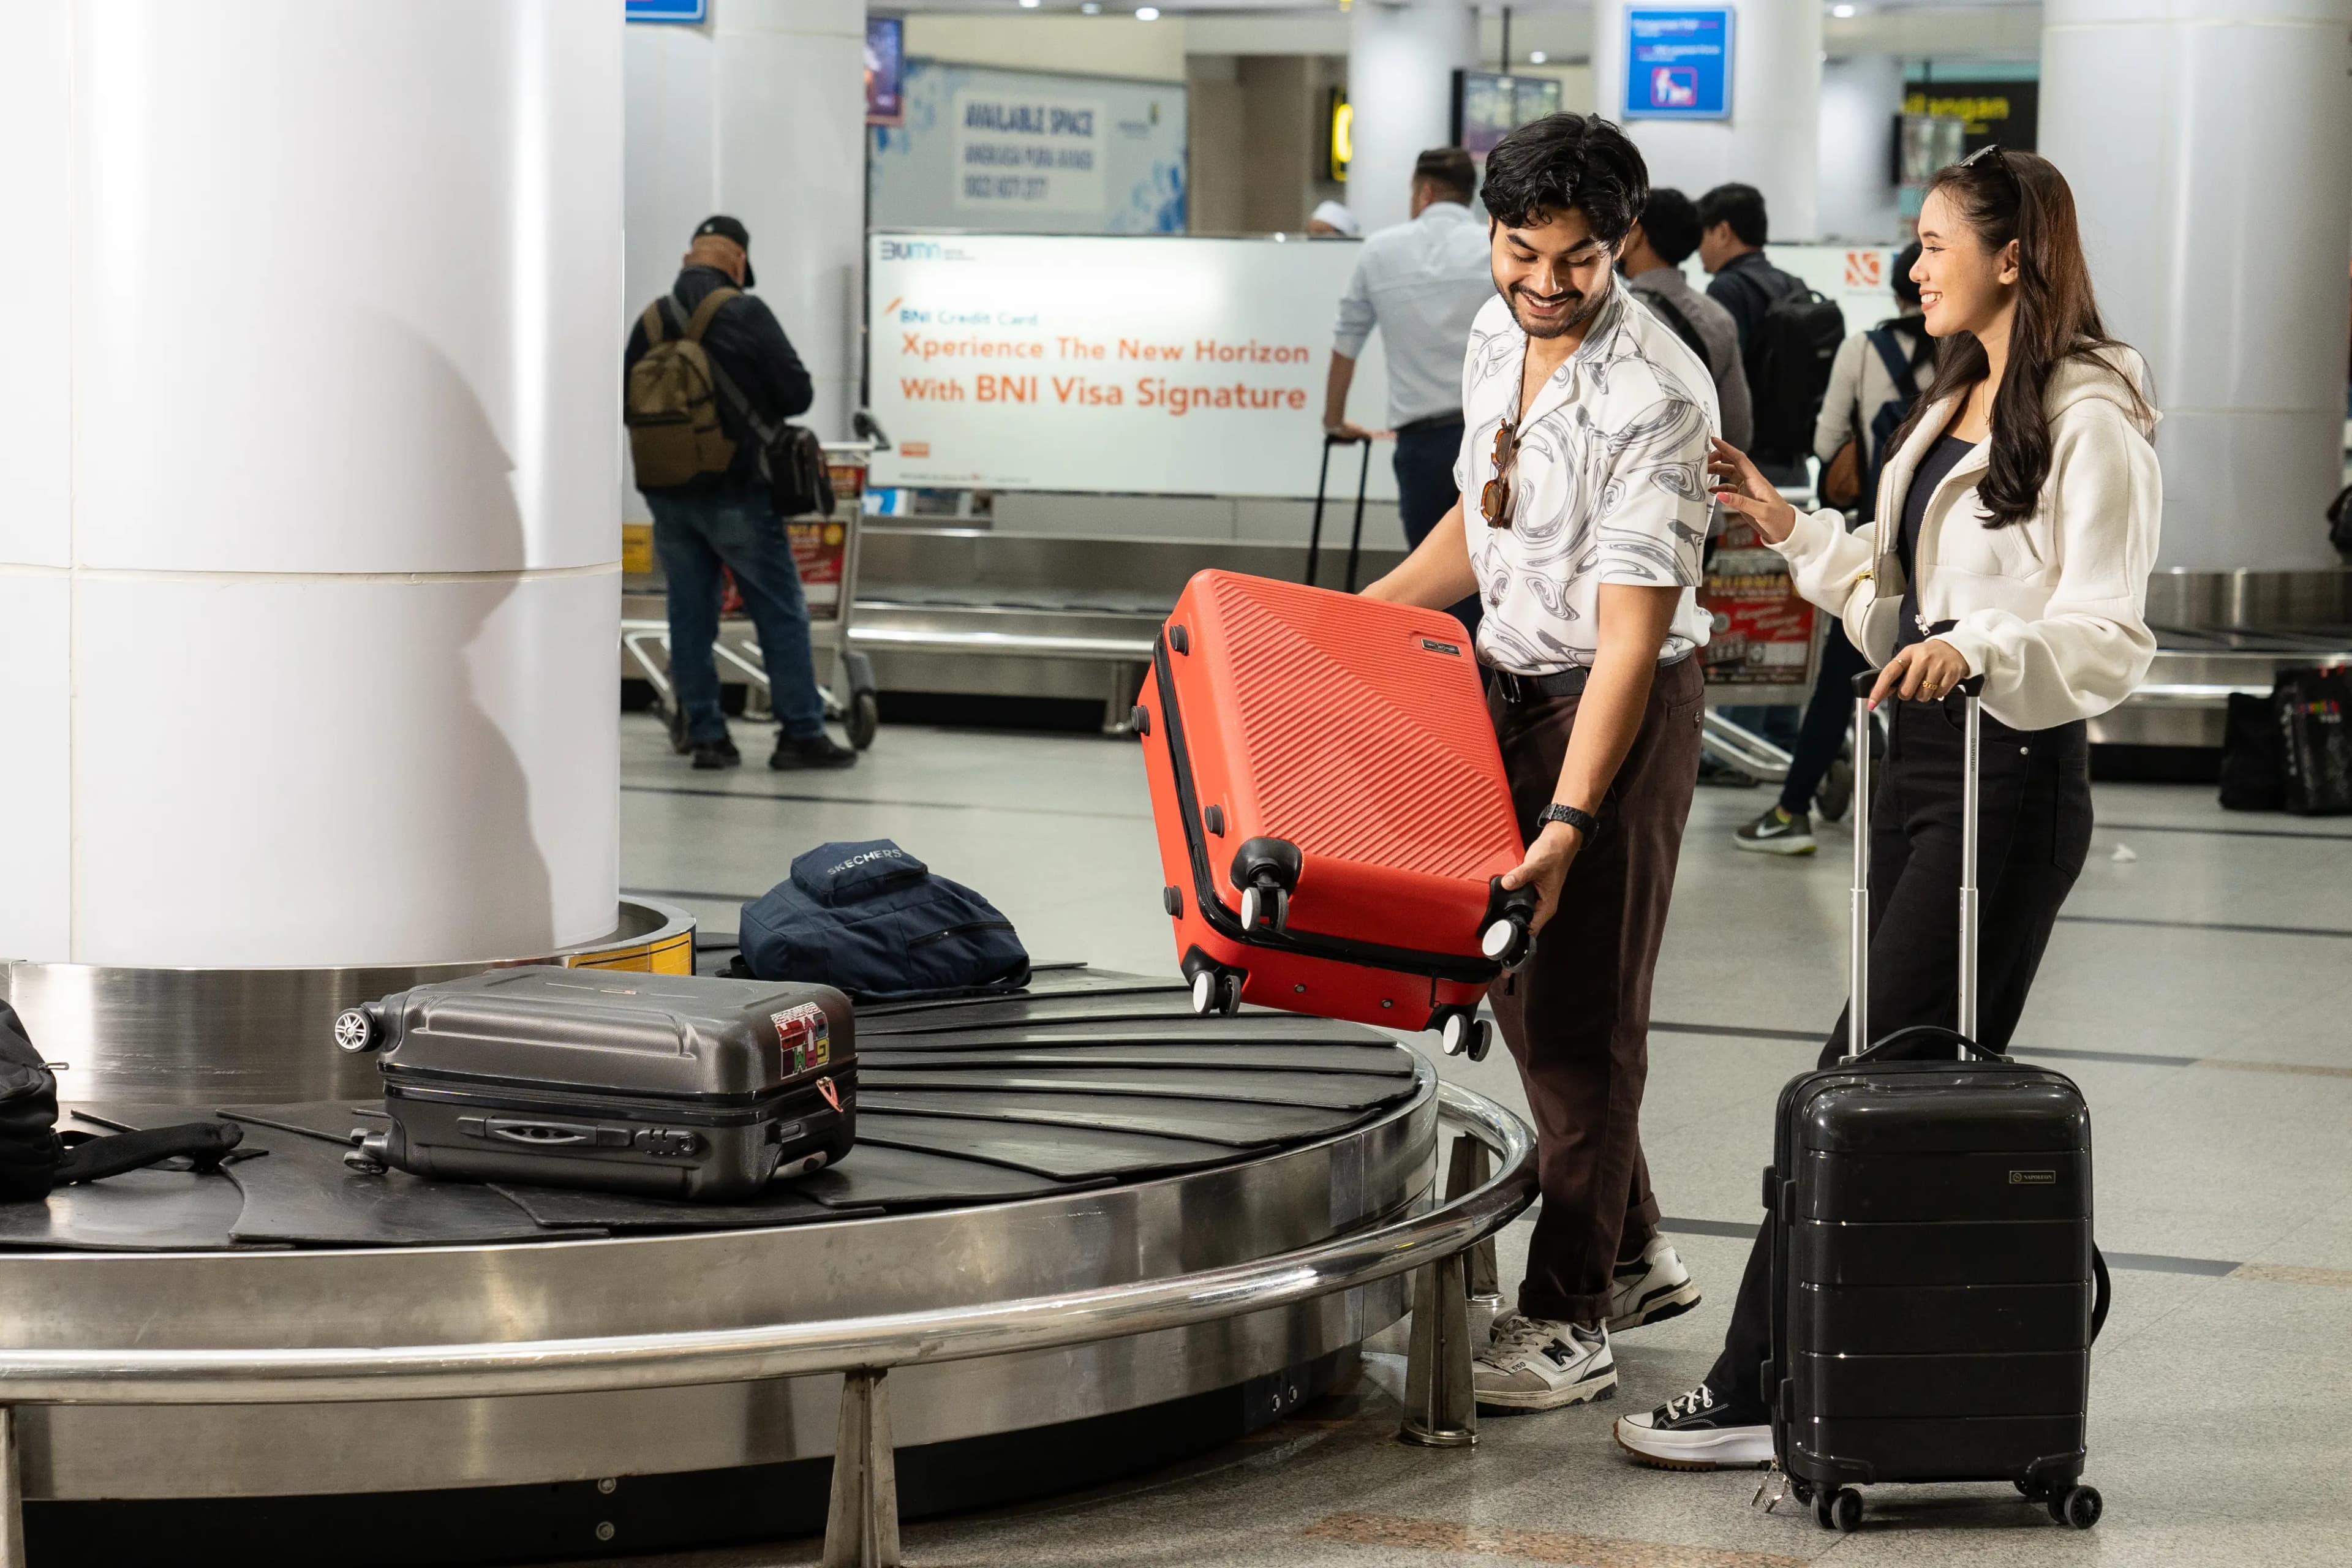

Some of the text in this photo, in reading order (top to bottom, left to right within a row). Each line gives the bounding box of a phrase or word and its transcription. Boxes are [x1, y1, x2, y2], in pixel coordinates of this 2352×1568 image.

[899, 309, 1039, 325] BNI Credit Card
[902, 333, 1309, 363] Xperience The New Horizon
[900, 374, 1307, 417] With BNI Visa Signature
[827, 849, 902, 875] SKECHERS
[1512, 1362, 1526, 1371] 550
